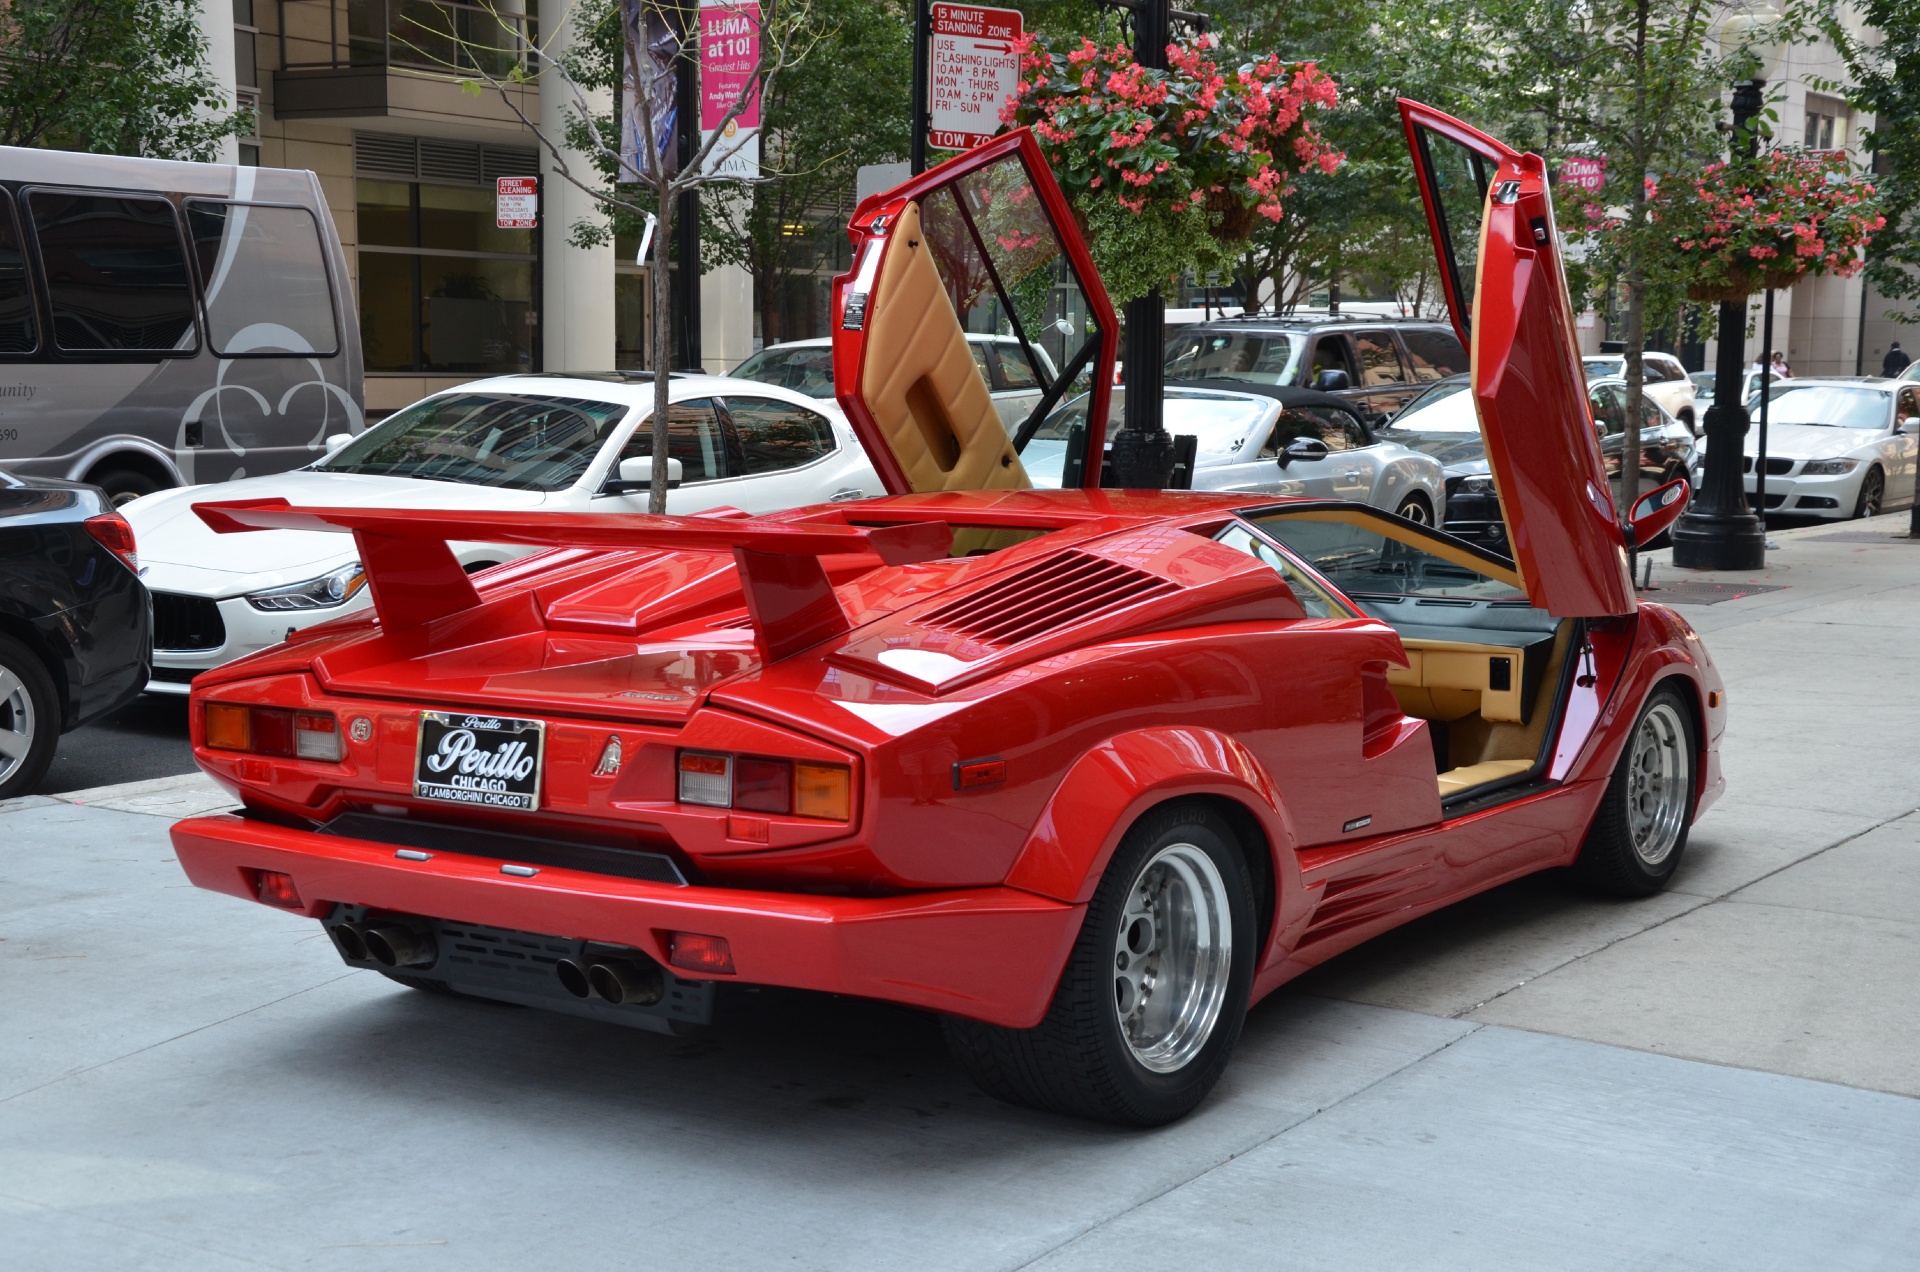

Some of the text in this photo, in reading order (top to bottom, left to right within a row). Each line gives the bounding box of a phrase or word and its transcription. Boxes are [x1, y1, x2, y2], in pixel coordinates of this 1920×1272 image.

[938, 8, 984, 23] 15 MINUTE
[708, 18, 750, 37] LUMA
[938, 20, 1012, 37] STANDING ZONE
[708, 38, 750, 58] at 10!
[937, 40, 955, 51] USE
[709, 60, 750, 72] Greatest Hits
[937, 52, 1016, 70] FLASHING LIGHTS
[972, 67, 978, 77] 8
[982, 68, 995, 78] PM
[936, 76, 957, 87] MON
[968, 79, 999, 91] THURS
[709, 92, 724, 101] Andy
[972, 92, 977, 102] 6
[980, 92, 994, 102] PM
[935, 100, 951, 111] FRI
[960, 102, 980, 113] SUN
[935, 132, 965, 147] TOW
[712, 160, 747, 173] UMA
[1567, 163, 1599, 175] LUMA
[461, 715, 501, 730] Perillo
[427, 729, 534, 781] Perillo
[451, 775, 507, 792] CHICAGO
[429, 787, 521, 807] LAMBORGHINI CHICAGO
